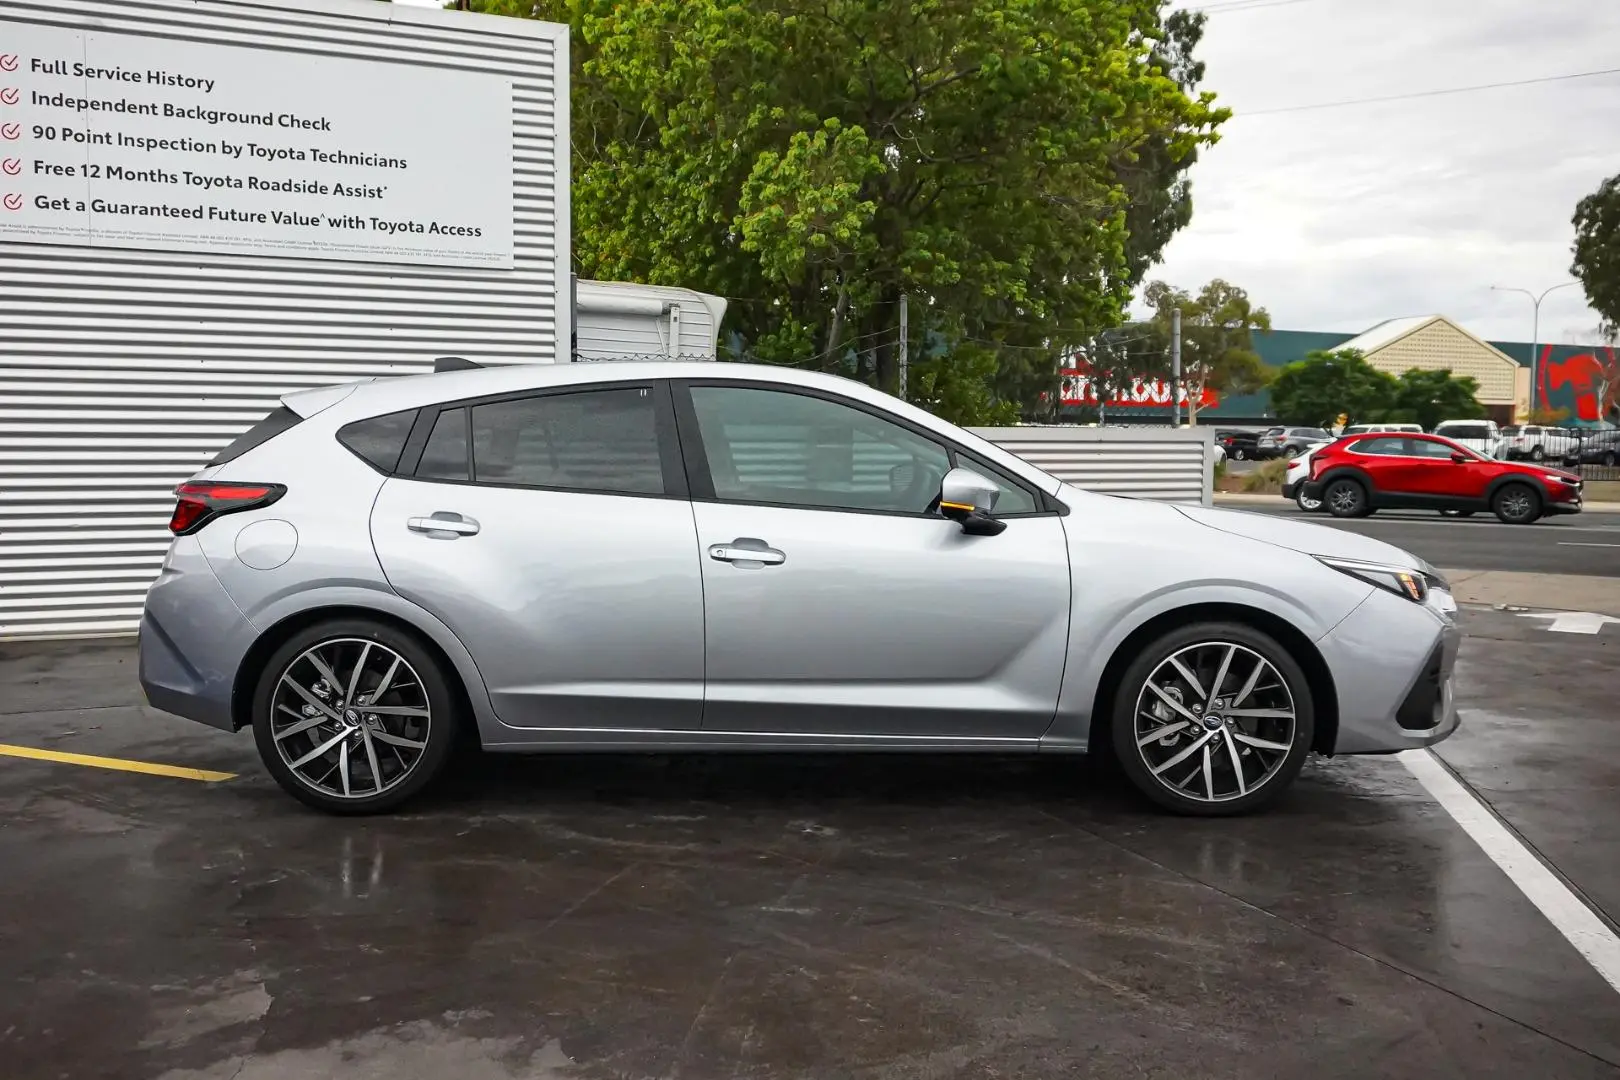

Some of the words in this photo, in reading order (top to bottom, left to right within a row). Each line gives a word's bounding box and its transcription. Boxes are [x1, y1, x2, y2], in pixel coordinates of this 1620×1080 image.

[31, 58, 68, 76] Full
[73, 62, 142, 83] Service
[147, 70, 215, 94] History
[32, 90, 159, 116] Independent
[163, 103, 274, 126] Background
[277, 114, 331, 132] Check
[32, 125, 57, 141] 90
[62, 127, 113, 146] Point
[117, 132, 217, 154] Inspection
[221, 140, 243, 159] by
[246, 143, 306, 162] Toyota
[309, 148, 407, 169] Technicians
[33, 159, 76, 177] Free
[80, 163, 101, 179] 12
[106, 165, 178, 184] Months
[182, 171, 243, 190] Toyota
[248, 176, 329, 195] Roadside
[34, 195, 71, 211] Get
[75, 201, 86, 212] a
[91, 198, 204, 219] Guaranteed
[208, 206, 267, 224] Future
[327, 214, 366, 230] with
[369, 217, 425, 235] Toyota
[428, 221, 482, 237] Access
